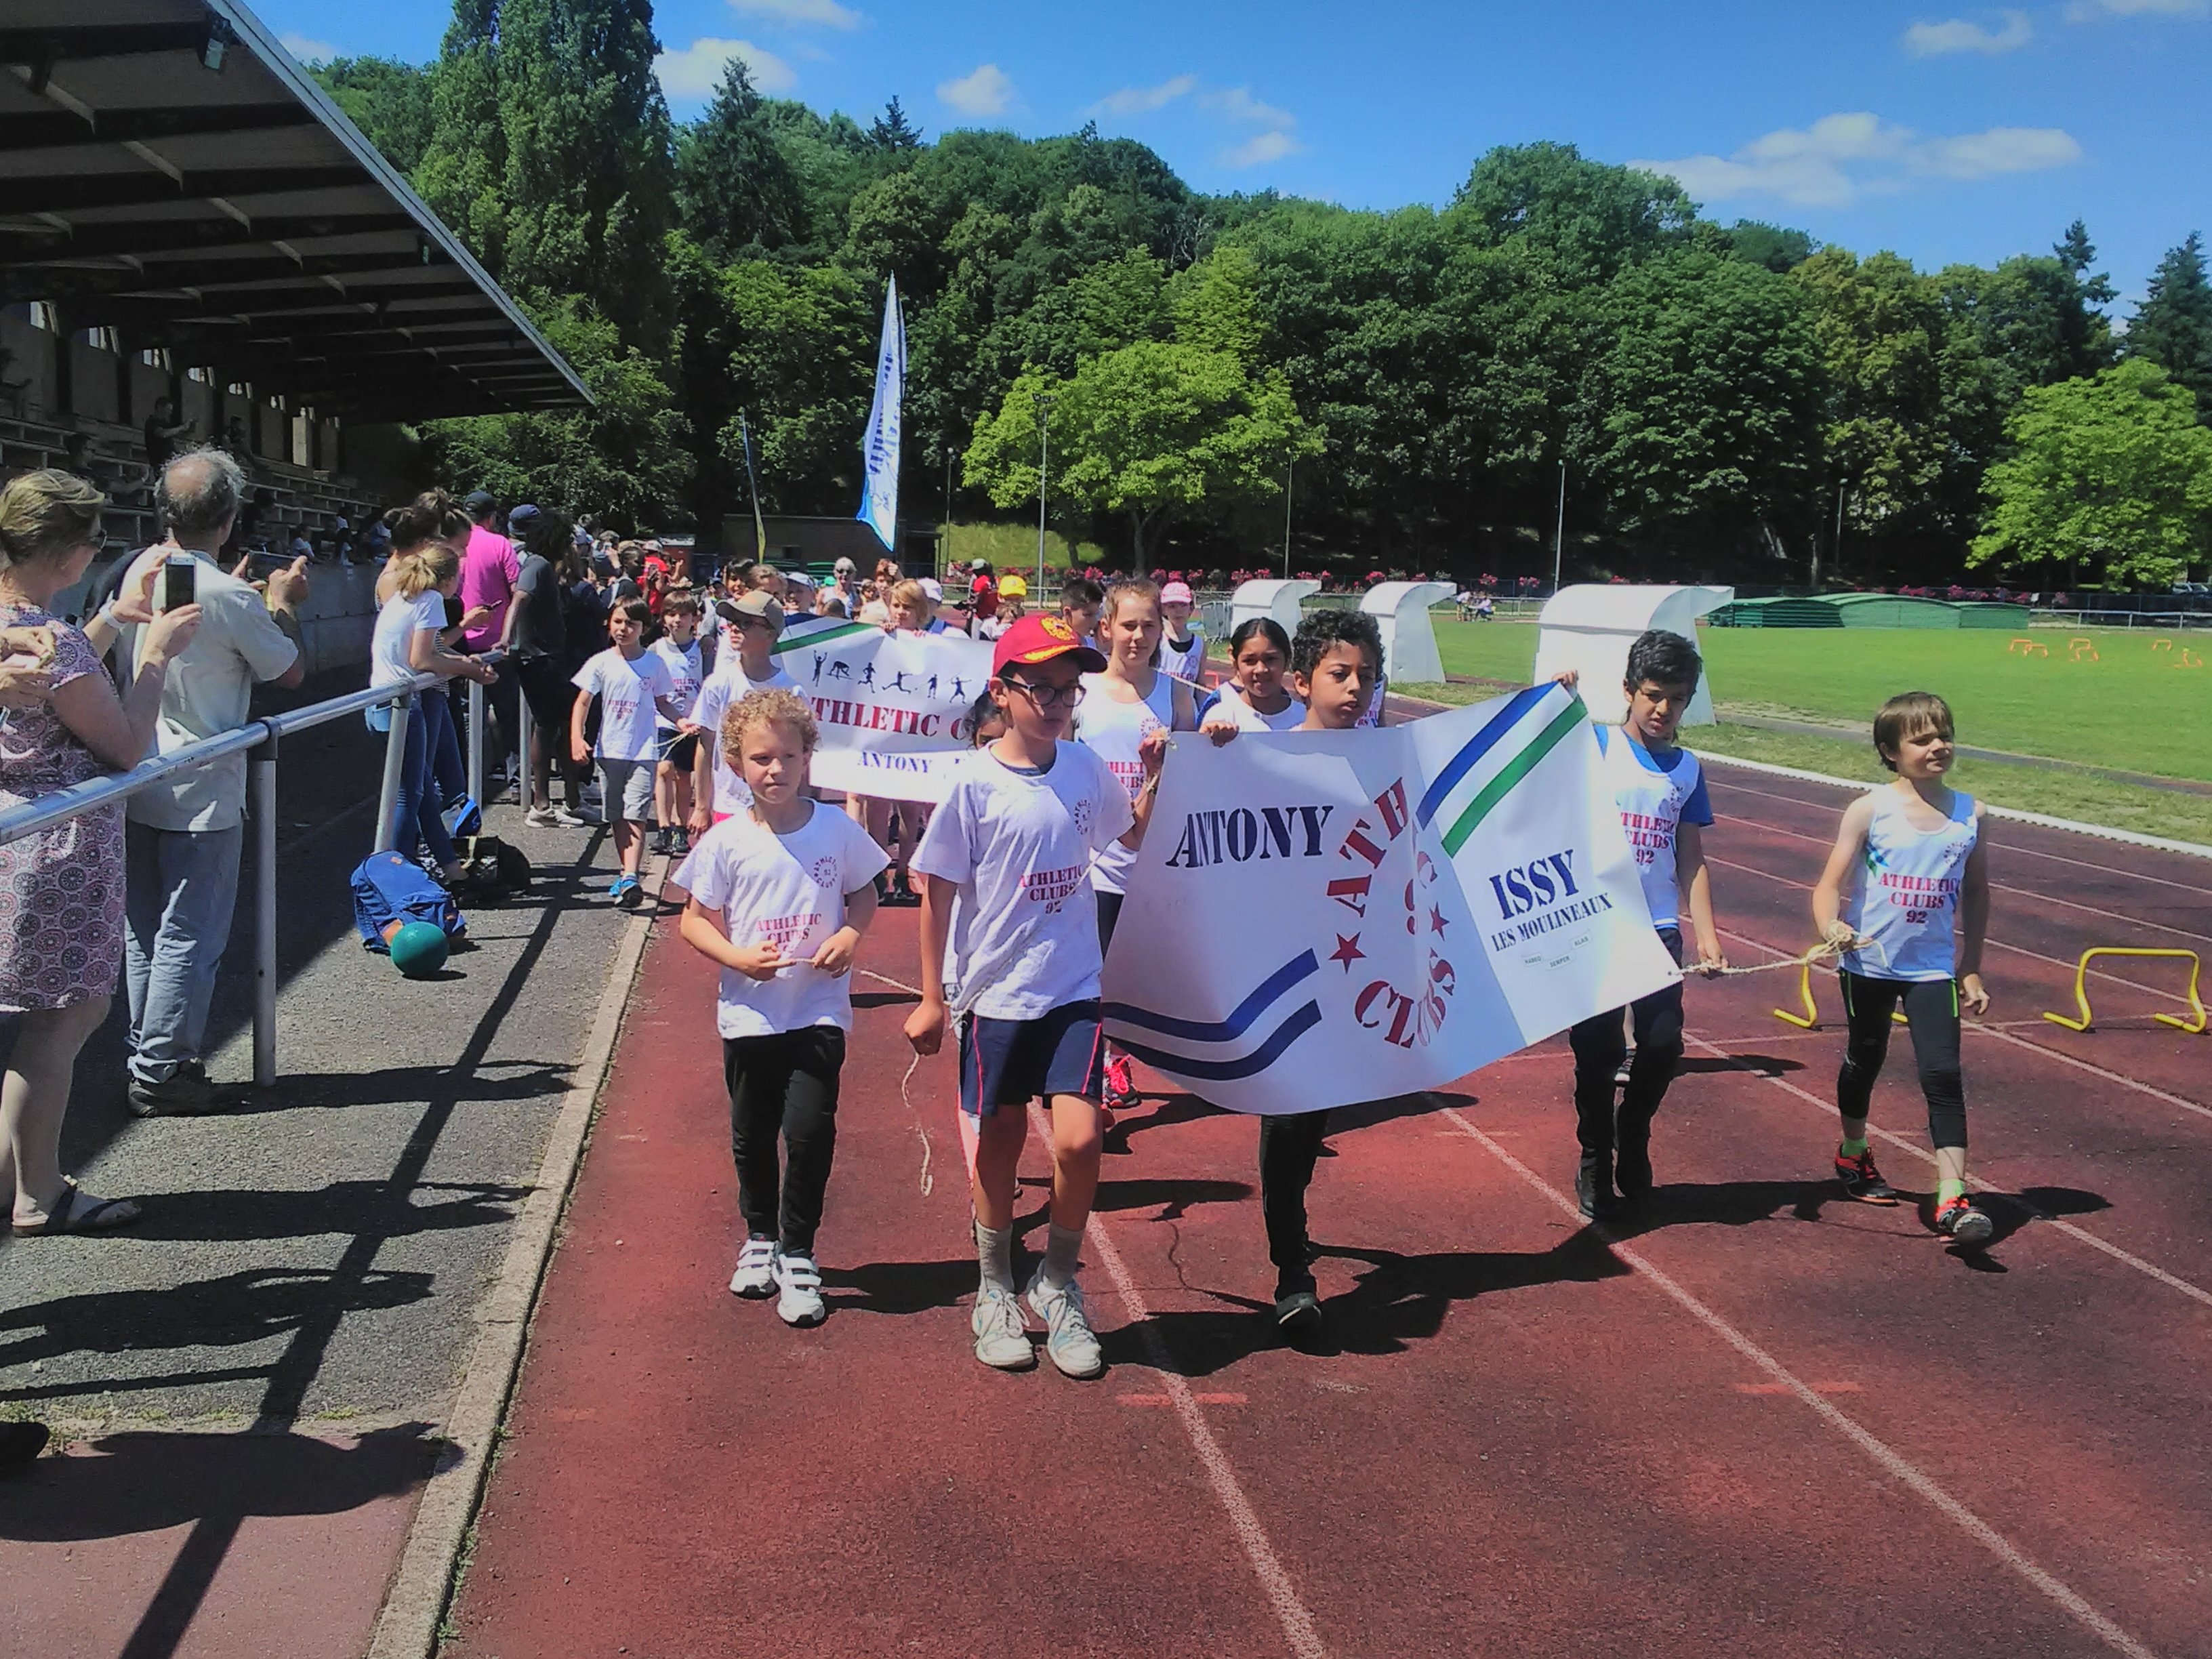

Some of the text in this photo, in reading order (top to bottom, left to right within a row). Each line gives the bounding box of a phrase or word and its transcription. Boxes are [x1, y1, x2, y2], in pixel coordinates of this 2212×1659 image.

[811, 697, 941, 737] THLETIC
[857, 752, 933, 773] ANTONY
[1620, 811, 1675, 835] THLETIC
[1165, 805, 1334, 868] ANTONY
[1636, 848, 1655, 864] 92
[1029, 882, 1076, 901] CLUBS
[1489, 848, 1579, 920] ISSY
[1879, 872, 1958, 893] ATHLETIC
[1889, 892, 1946, 909] CLUBS
[757, 914, 822, 932] ATHLETIC
[1491, 892, 1613, 951] LES MOULINEAUX
[1906, 910, 1929, 924] 92
